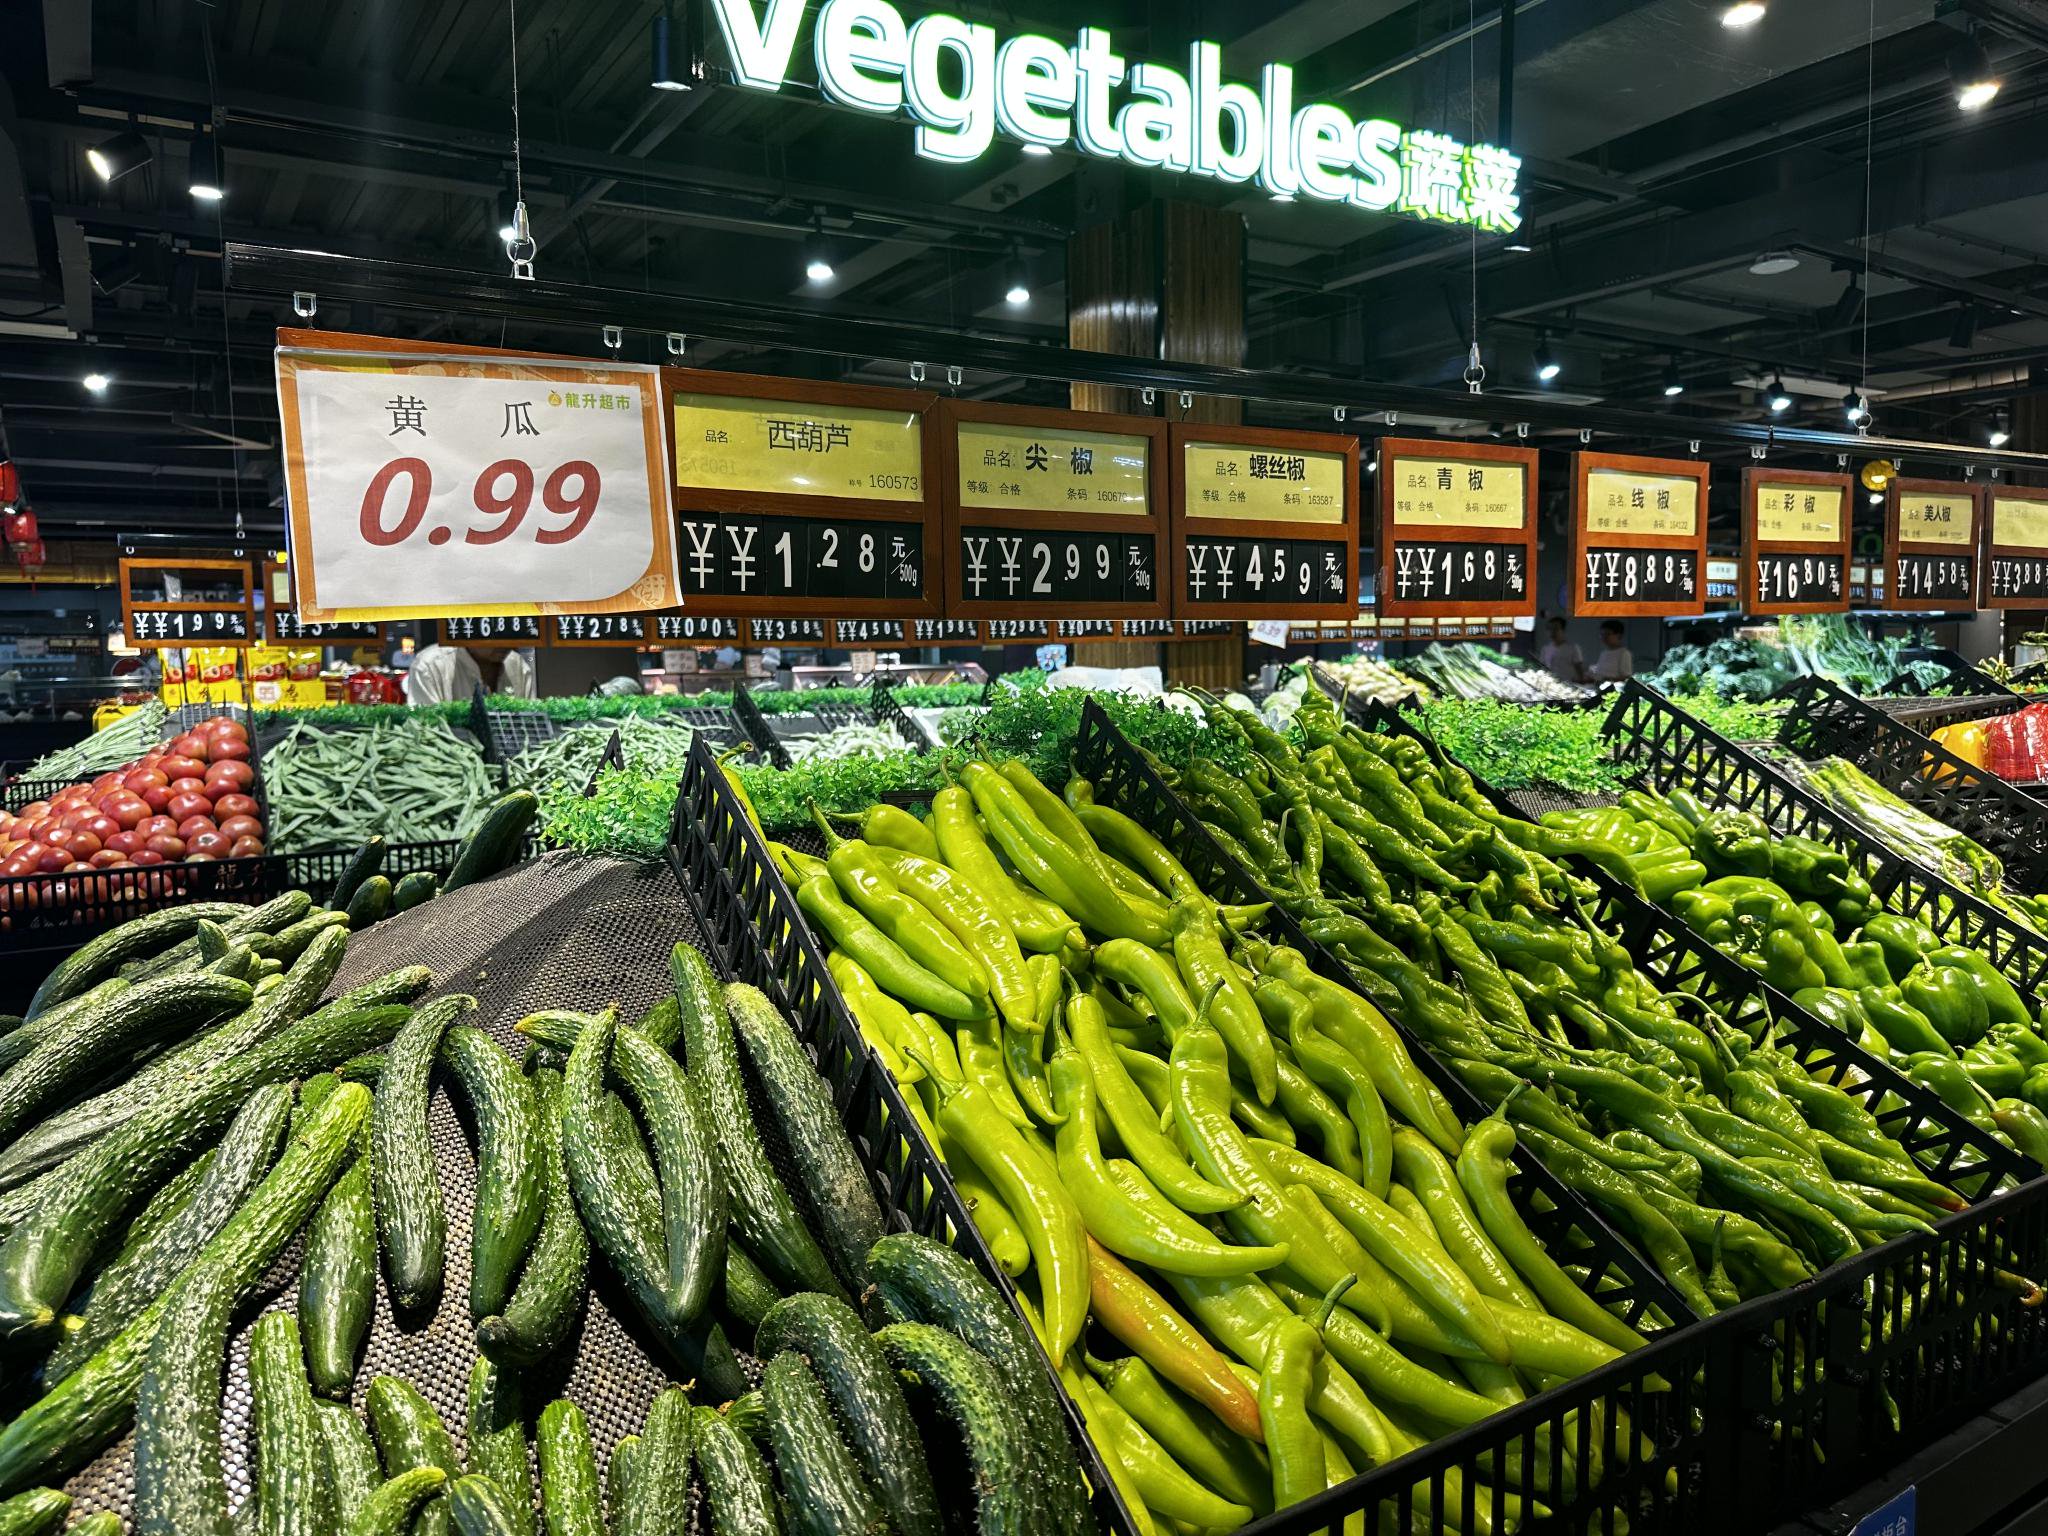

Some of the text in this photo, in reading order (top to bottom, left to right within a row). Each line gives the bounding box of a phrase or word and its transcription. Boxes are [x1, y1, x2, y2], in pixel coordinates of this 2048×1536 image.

[1397, 129, 1523, 234] 蔬菜
[565, 392, 631, 410] 龍升超市
[766, 419, 852, 453] 西葫芦
[1025, 443, 1093, 475] 尖椒
[1250, 454, 1306, 481] 螺丝椒
[869, 474, 919, 491] 160573
[999, 483, 1021, 496] 合格
[1437, 467, 1484, 492] 青椒
[359, 457, 602, 547] 0.99
[1228, 490, 1247, 502] 合格
[1308, 495, 1333, 506] 163587
[1924, 504, 1951, 522] 美人椒
